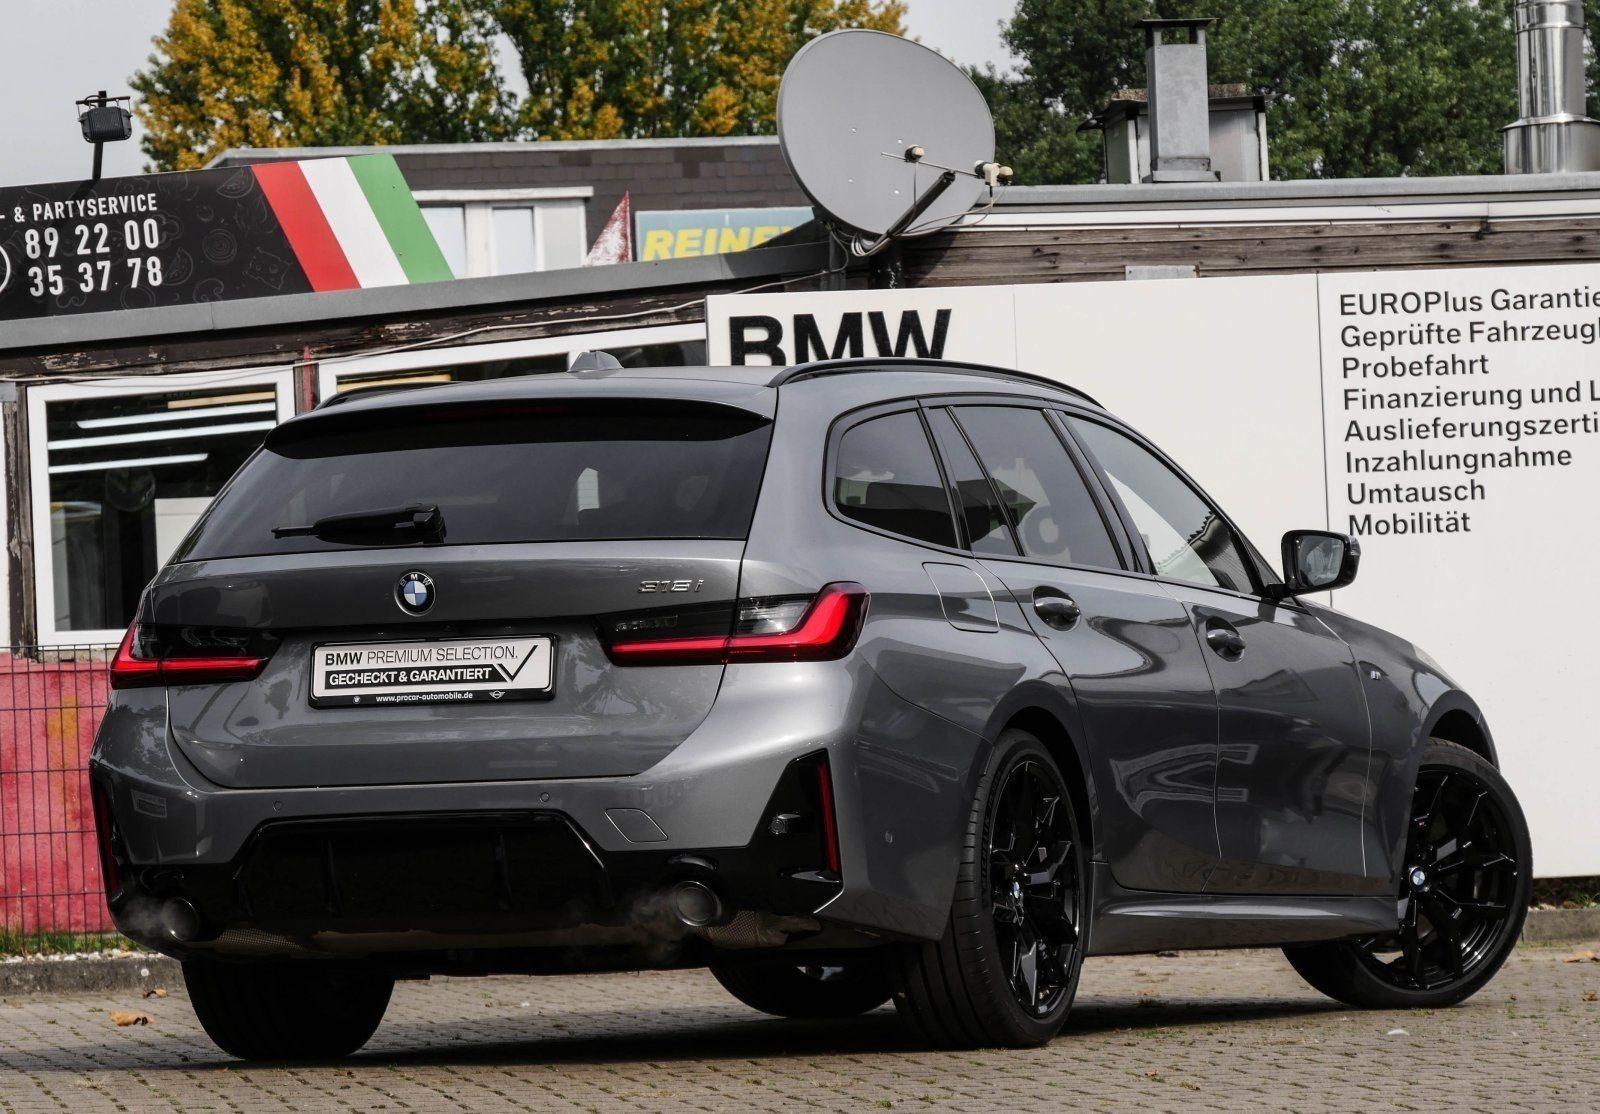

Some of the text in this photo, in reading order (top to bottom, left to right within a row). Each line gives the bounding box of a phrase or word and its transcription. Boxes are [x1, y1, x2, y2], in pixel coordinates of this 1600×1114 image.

[33, 193, 158, 221] PARTYSERVICE
[25, 218, 159, 259] 89 22 00
[28, 256, 163, 297] 35 37 78
[1339, 291, 1483, 316] EUROPlus
[729, 308, 952, 366] BMW
[1341, 317, 1600, 351] Geprüfte Fahrzeug
[1342, 354, 1489, 379] Probefahrt
[1343, 385, 1522, 410] Finanzierung
[1530, 380, 1581, 404] und
[1346, 446, 1572, 475] Inzahlungnahme
[1347, 479, 1486, 505] Umtausch
[1349, 510, 1471, 536] Mobilität
[325, 645, 518, 666] BMW PREMIUM SELECTION.
[329, 667, 492, 686] GECHECKT & GARANTIERT
[376, 691, 473, 703] www.procar-automobile.de
